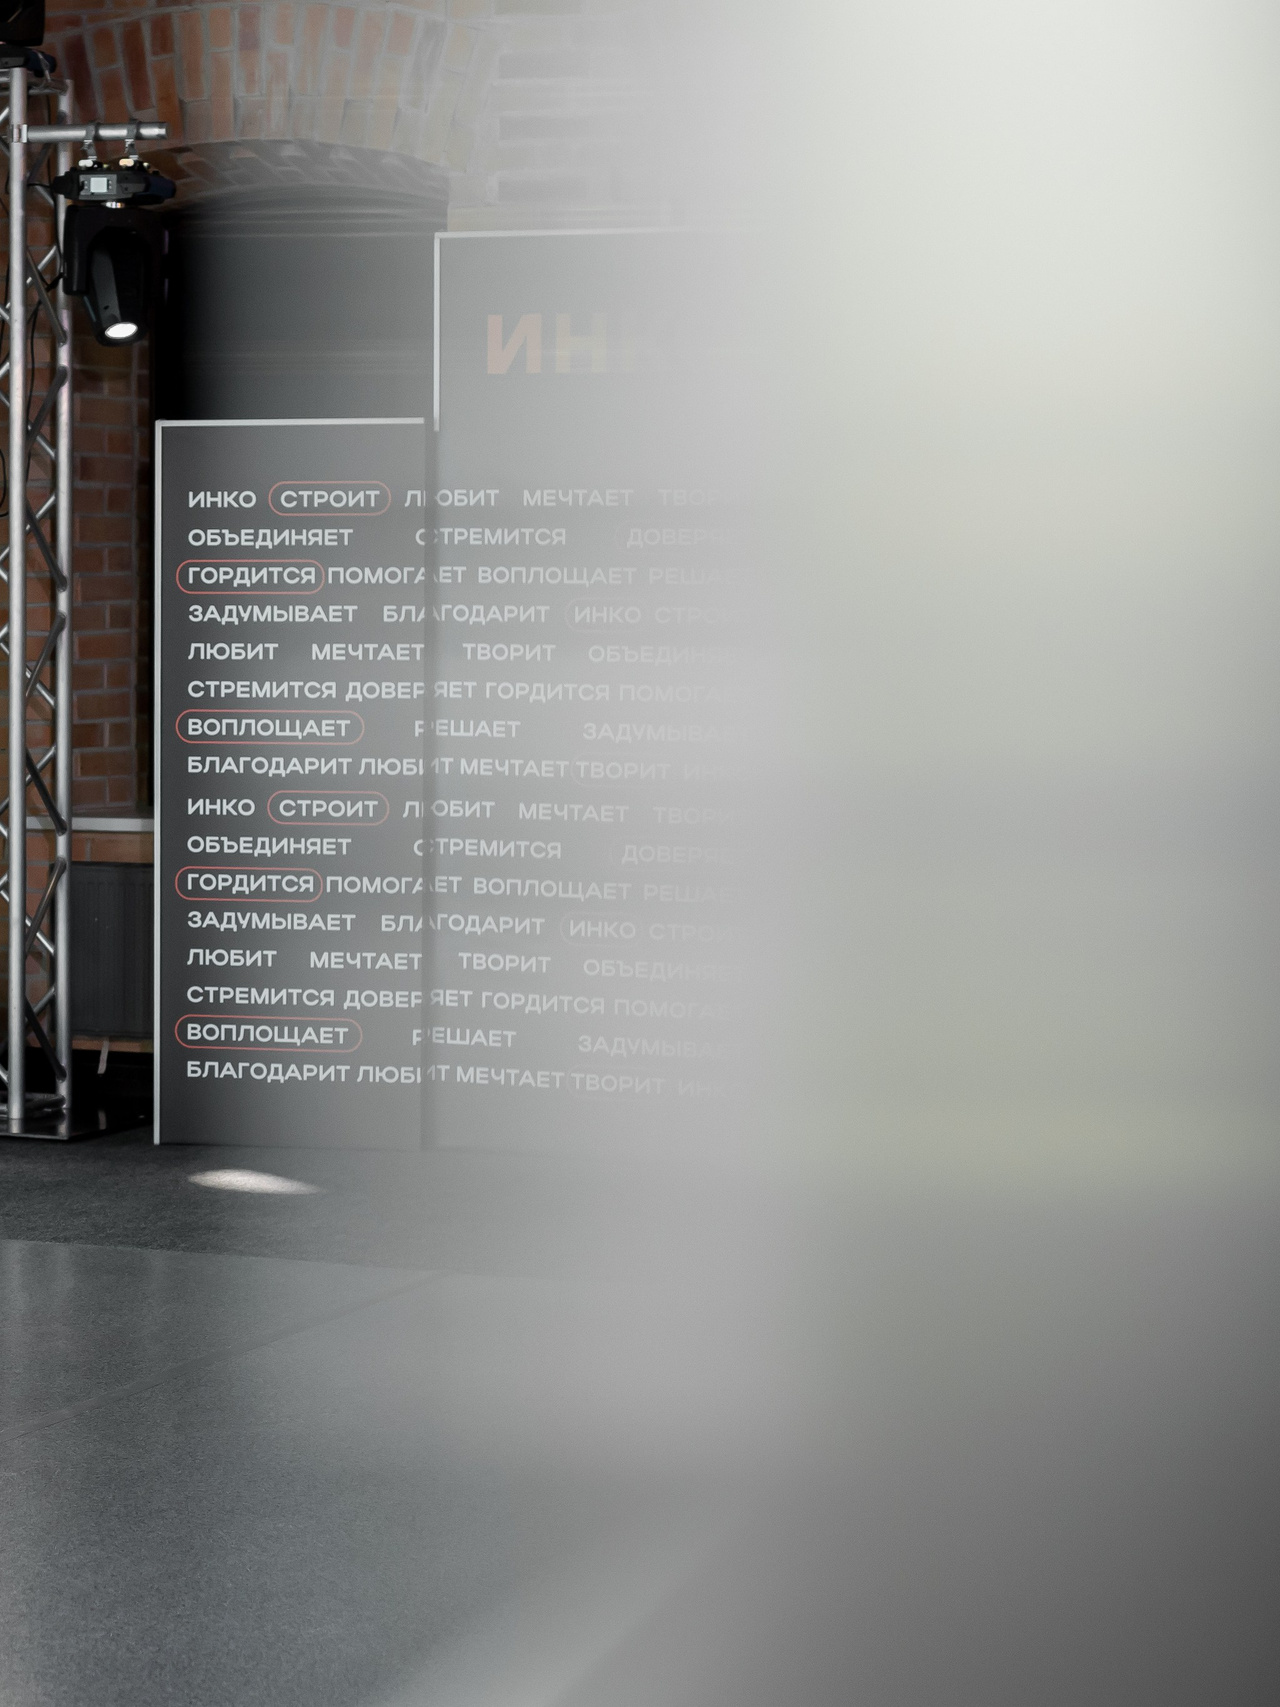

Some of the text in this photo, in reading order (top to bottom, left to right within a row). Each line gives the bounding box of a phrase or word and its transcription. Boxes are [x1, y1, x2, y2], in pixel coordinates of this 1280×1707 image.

[487, 313, 655, 375] ИН
[188, 488, 745, 508] ИНКО СТРОИТ ЛЮБИТ МЕЧТАЕТ ТВОР
[188, 529, 354, 549] ОБЪЕДИНЯЕТ
[415, 528, 566, 546] СТРЕМИТСЯ
[188, 567, 316, 587] ГОРДИТСЯ
[328, 566, 467, 584] ПОМОГАЕТ
[478, 566, 637, 587] ВОПЛОЩАЕТ
[188, 604, 748, 625] ЗАДУМЫВАЕТ БЛАГОДАРИТ ИНКО СТРО
[188, 643, 278, 660] ЛЮБИТ
[311, 643, 424, 661] МЕЧТАЕТ
[462, 642, 556, 661] ТВОРИТ
[187, 680, 745, 703] СТРЕМИТСЯ ДОВЕРЯЕТ ГОРДИТСЯ ПОМОГА
[188, 719, 351, 739] ВОПЛОЩАЕТ
[414, 719, 520, 738] РЕШАЕТ
[188, 756, 352, 777] БЛАГОДАРИТ
[358, 757, 454, 776] ЛЮБИТ
[460, 758, 569, 778] МЕЧТАЕТ
[576, 761, 671, 780] ТВОРИТ
[187, 798, 255, 816] ИНКО
[279, 800, 378, 818] СТРОИТ
[402, 800, 495, 818] ЛЮБИТ
[519, 803, 629, 823] МЕЧТАЕТ
[187, 836, 352, 857] ОБЪЕДИНЯЕТ
[413, 837, 562, 859] СТРЕМИТСЯ
[187, 873, 744, 903] ГОРДИТСЯ ПОМОГАЕТ ВОПЛОЩАЕТ РЕШАЕ
[187, 911, 744, 943] ЗАДУМЫВАЕТ БЛАГОДАРИТ ИНКО СТРОИ
[187, 948, 277, 967] ЛЮБИТ
[310, 951, 422, 970] МЕЧТАЕТ
[458, 952, 551, 973] ТВОРИТ
[187, 986, 334, 1006] СТРЕМИТСЯ
[343, 988, 473, 1010] ДОВЕРЯЕТ
[481, 992, 605, 1014] ГОРДИТСЯ
[187, 1024, 348, 1046] ВОПЛОЩАЕТ
[412, 1027, 517, 1048] РЕШАЕТ
[187, 1061, 351, 1083] БЛАГОДАРИТ
[357, 1064, 451, 1084] ЛЮБИТ
[456, 1065, 565, 1089] МЕЧТАЕТ
[571, 1072, 667, 1095] ТВОРИТ
